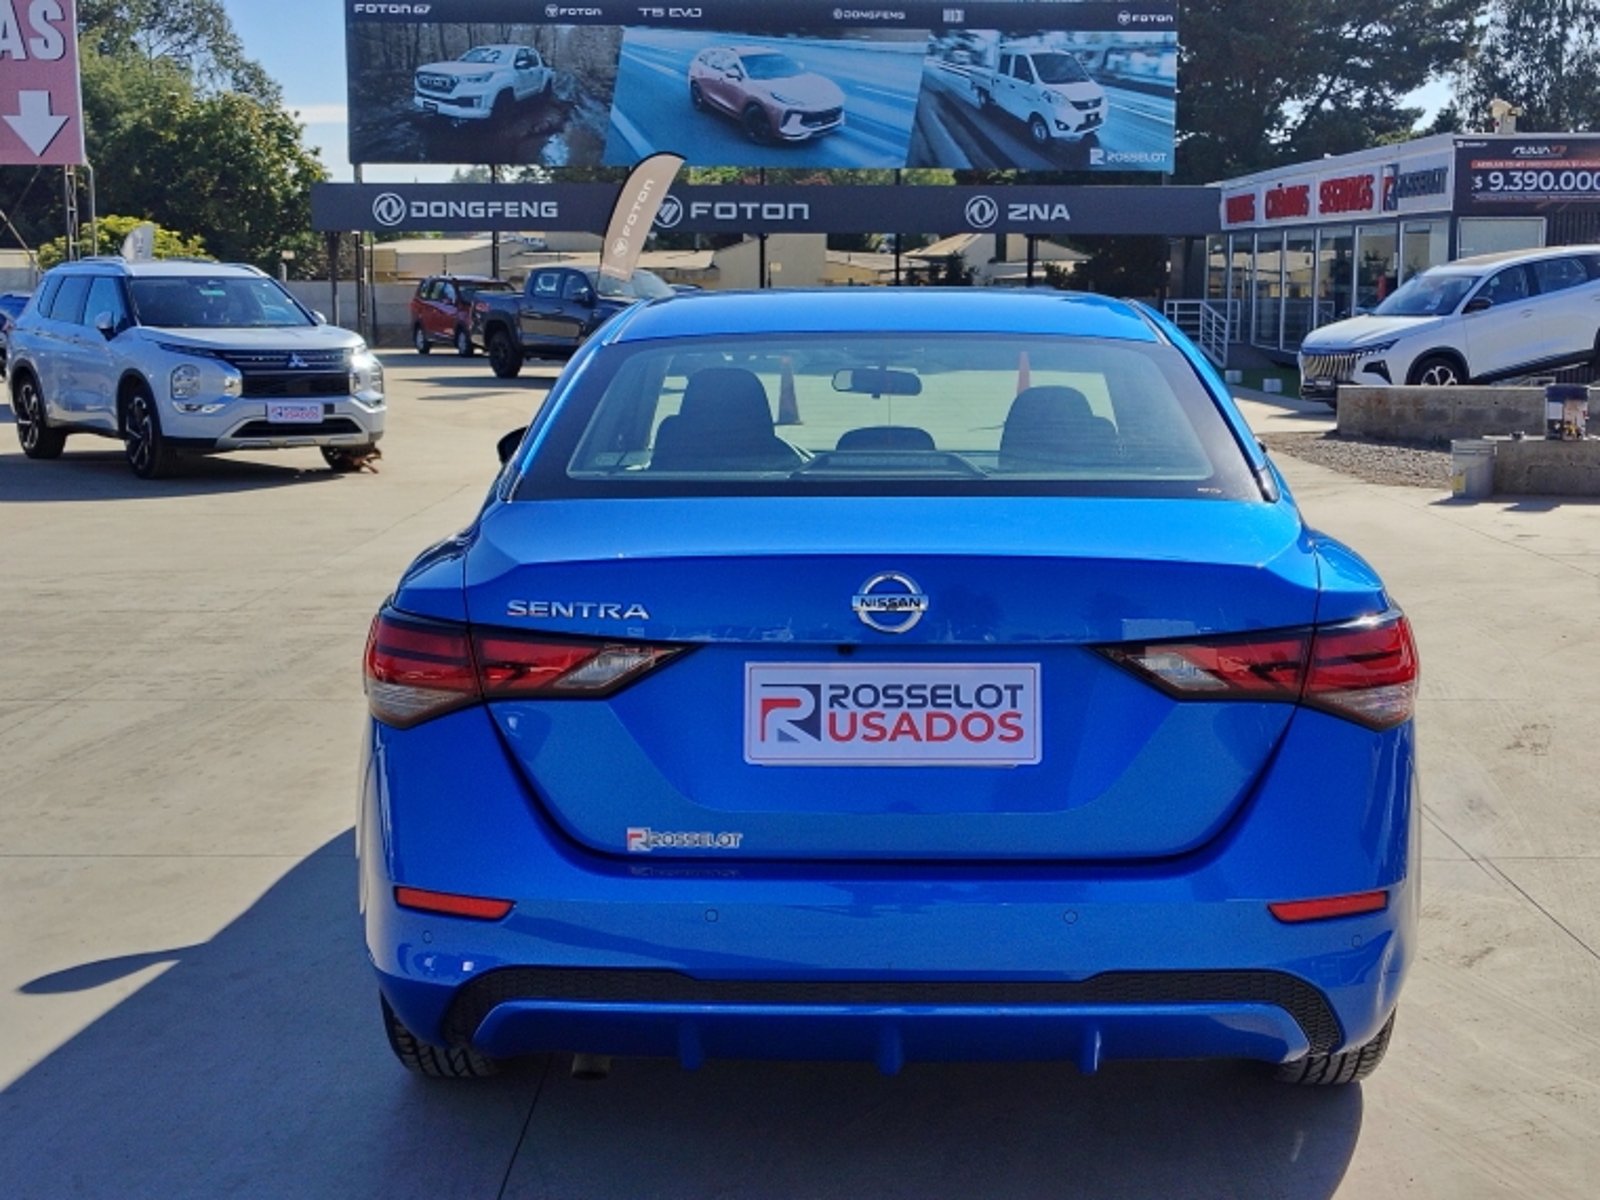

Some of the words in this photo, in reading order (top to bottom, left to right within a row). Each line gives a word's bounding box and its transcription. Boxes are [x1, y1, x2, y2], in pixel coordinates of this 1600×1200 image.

[353, 3, 411, 14] FOTON
[558, 7, 603, 16] FOTON
[1131, 13, 1174, 22] FOTON
[1106, 152, 1167, 163] ROSSELOT
[410, 201, 559, 218] DONGFENG
[621, 178, 656, 238] FOTON
[690, 202, 810, 220] FOTON
[1007, 203, 1071, 221] ZNA
[507, 599, 650, 621] SENTRA
[860, 597, 921, 609] NISSAN
[828, 683, 1024, 710] ROSSELOT
[828, 711, 1025, 743] USADOS
[650, 832, 743, 849] ROSSELOT
